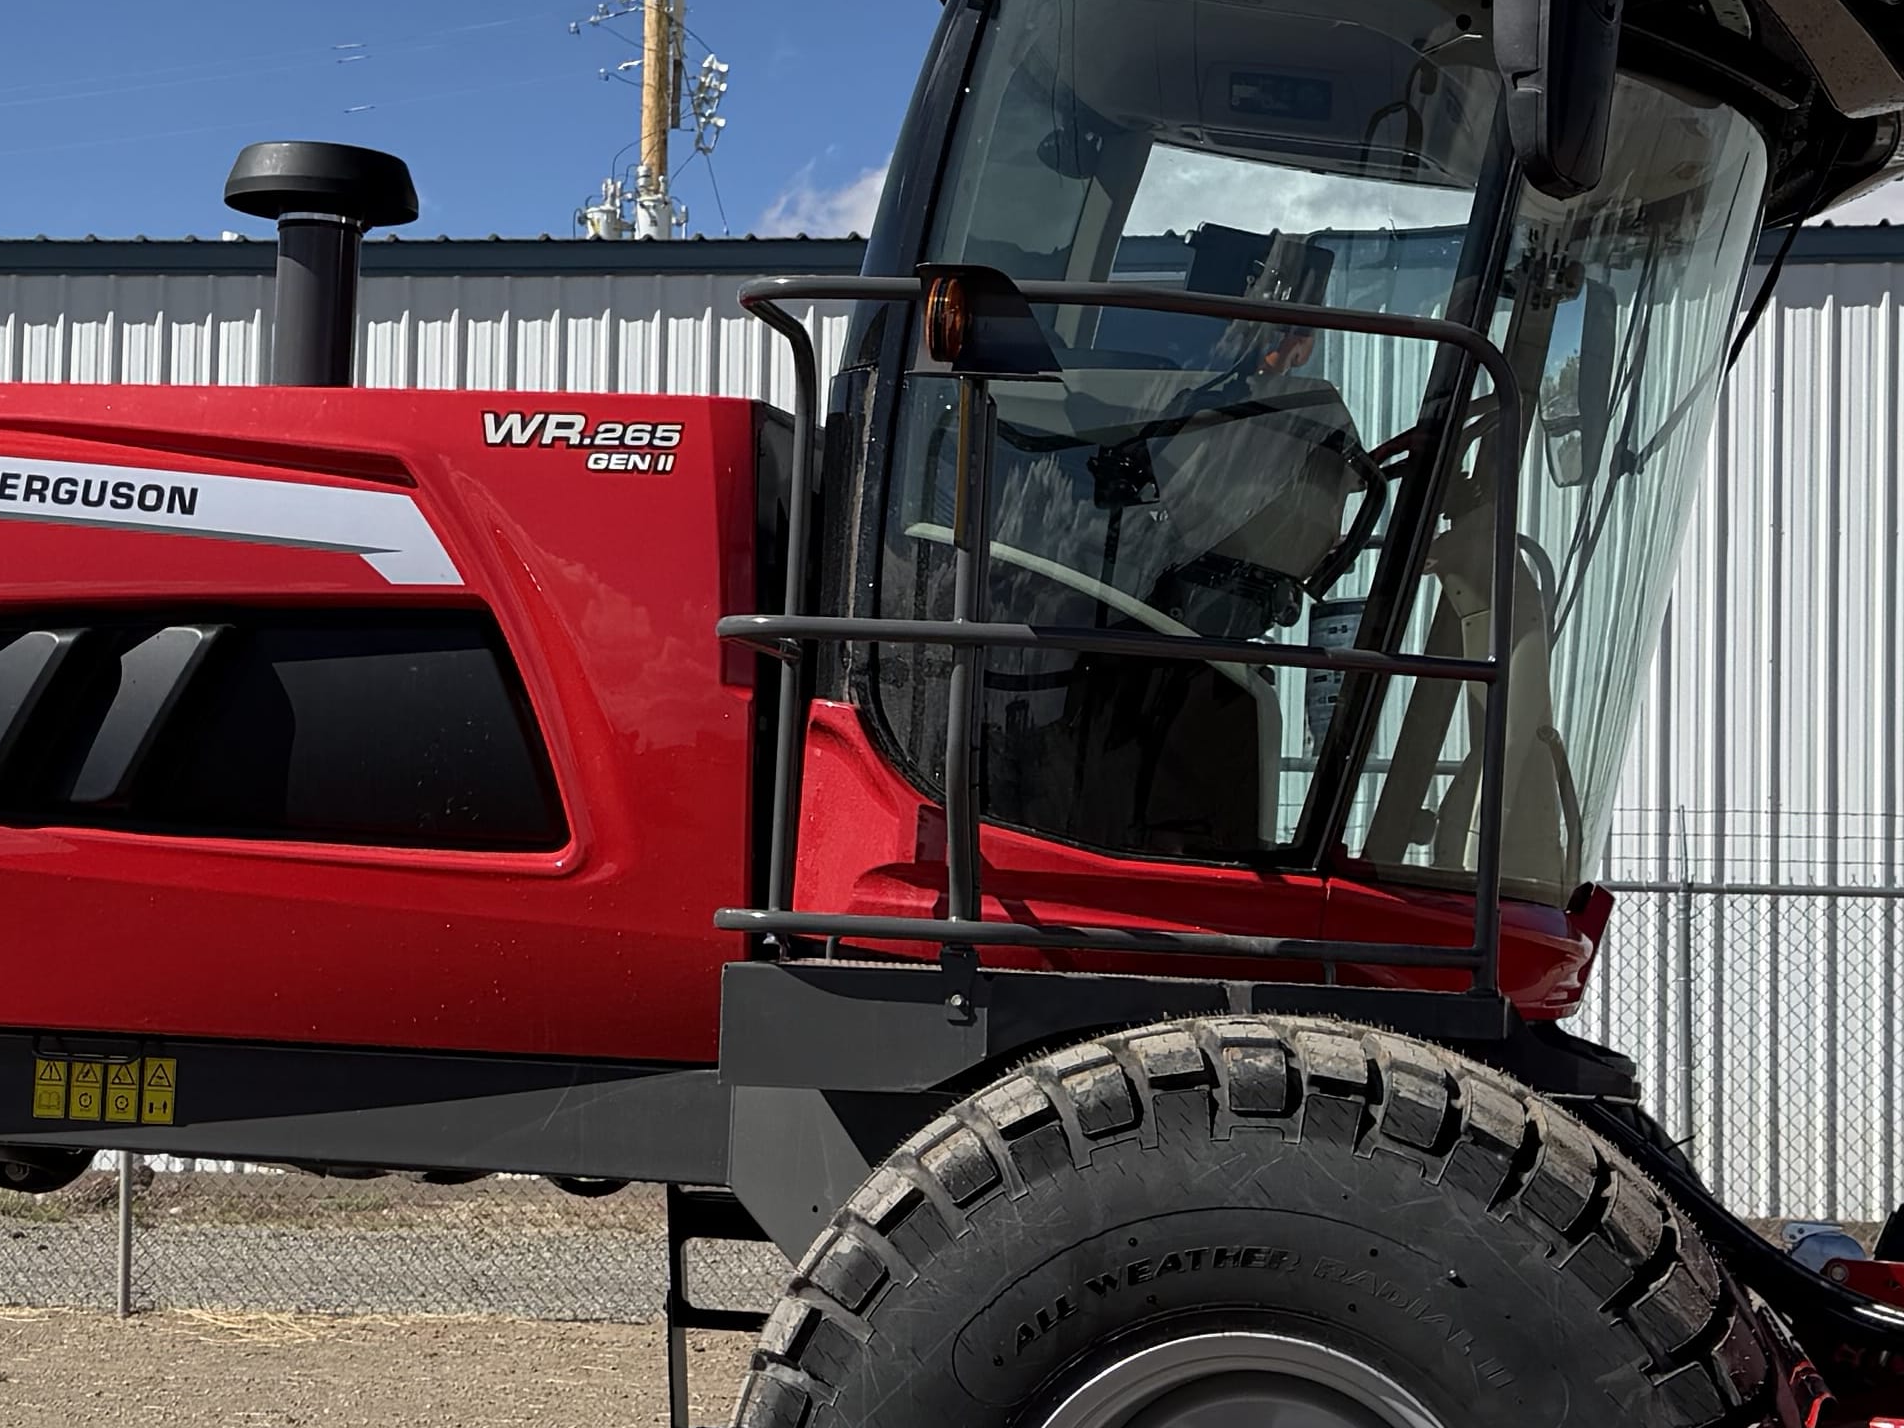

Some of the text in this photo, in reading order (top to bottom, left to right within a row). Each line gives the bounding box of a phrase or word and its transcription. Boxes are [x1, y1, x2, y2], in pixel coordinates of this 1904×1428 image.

[482, 409, 682, 449] WR.265
[586, 451, 676, 473] GEN II
[1010, 1294, 1078, 1357] ALL
[1085, 1245, 1302, 1299] WEATHER
[1312, 1258, 1478, 1358] RADIAL
